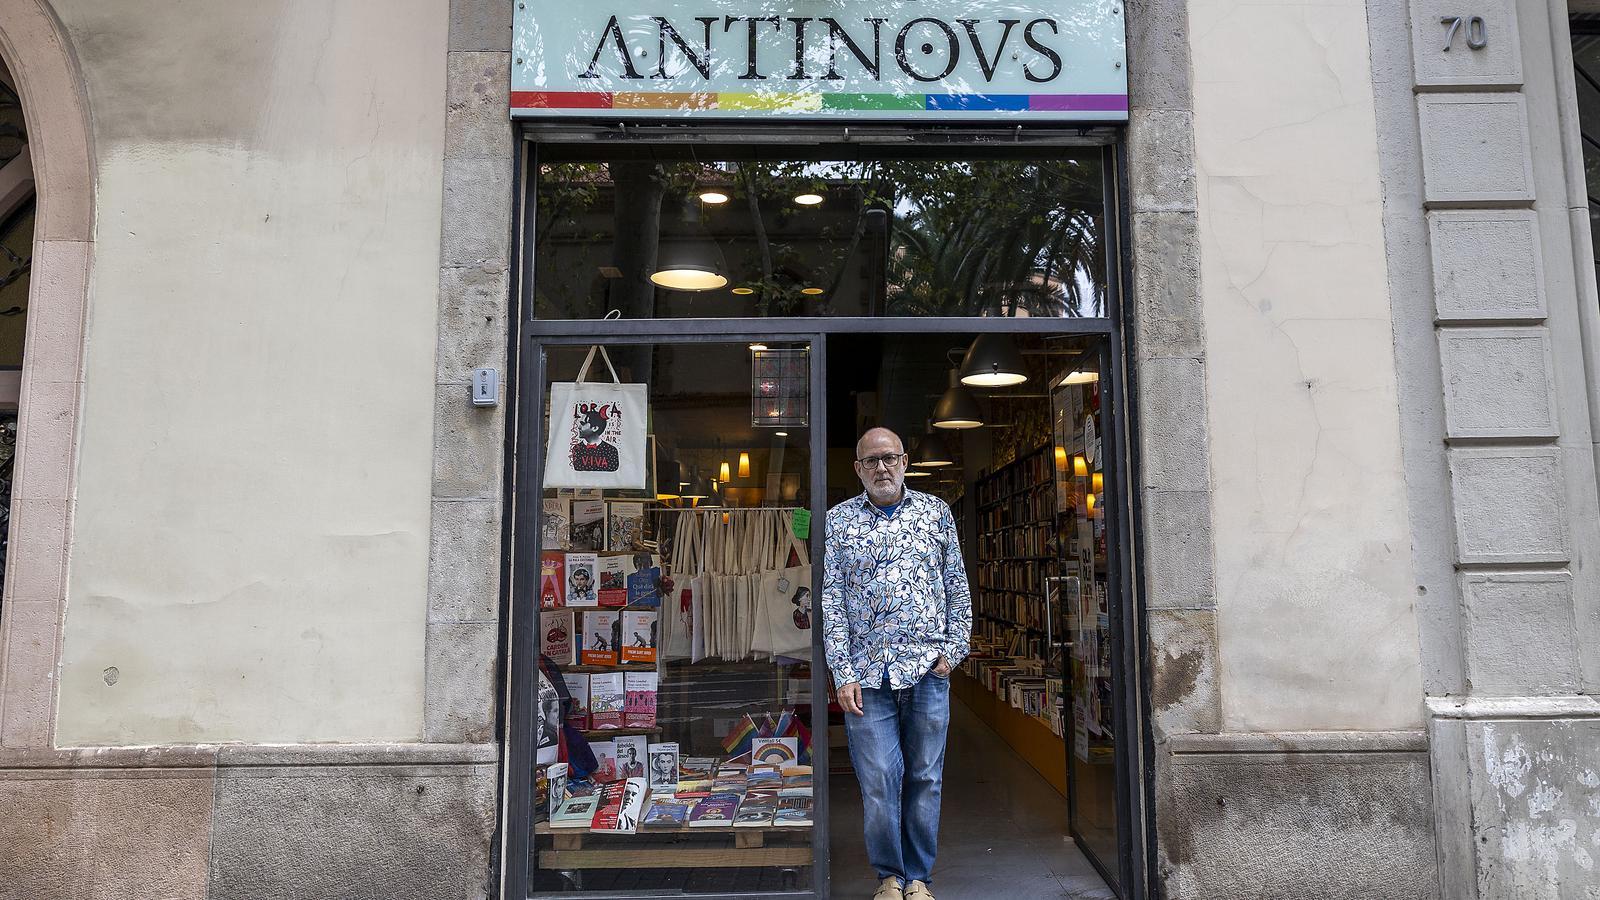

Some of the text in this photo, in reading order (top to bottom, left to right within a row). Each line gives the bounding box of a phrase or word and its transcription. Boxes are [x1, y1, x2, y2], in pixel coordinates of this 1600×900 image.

[1440, 16, 1488, 52] 70
[577, 14, 1063, 83] ANTINOVS
[573, 402, 622, 421] LORCA
[606, 435, 617, 443] AIR
[581, 455, 609, 468] VIVA
